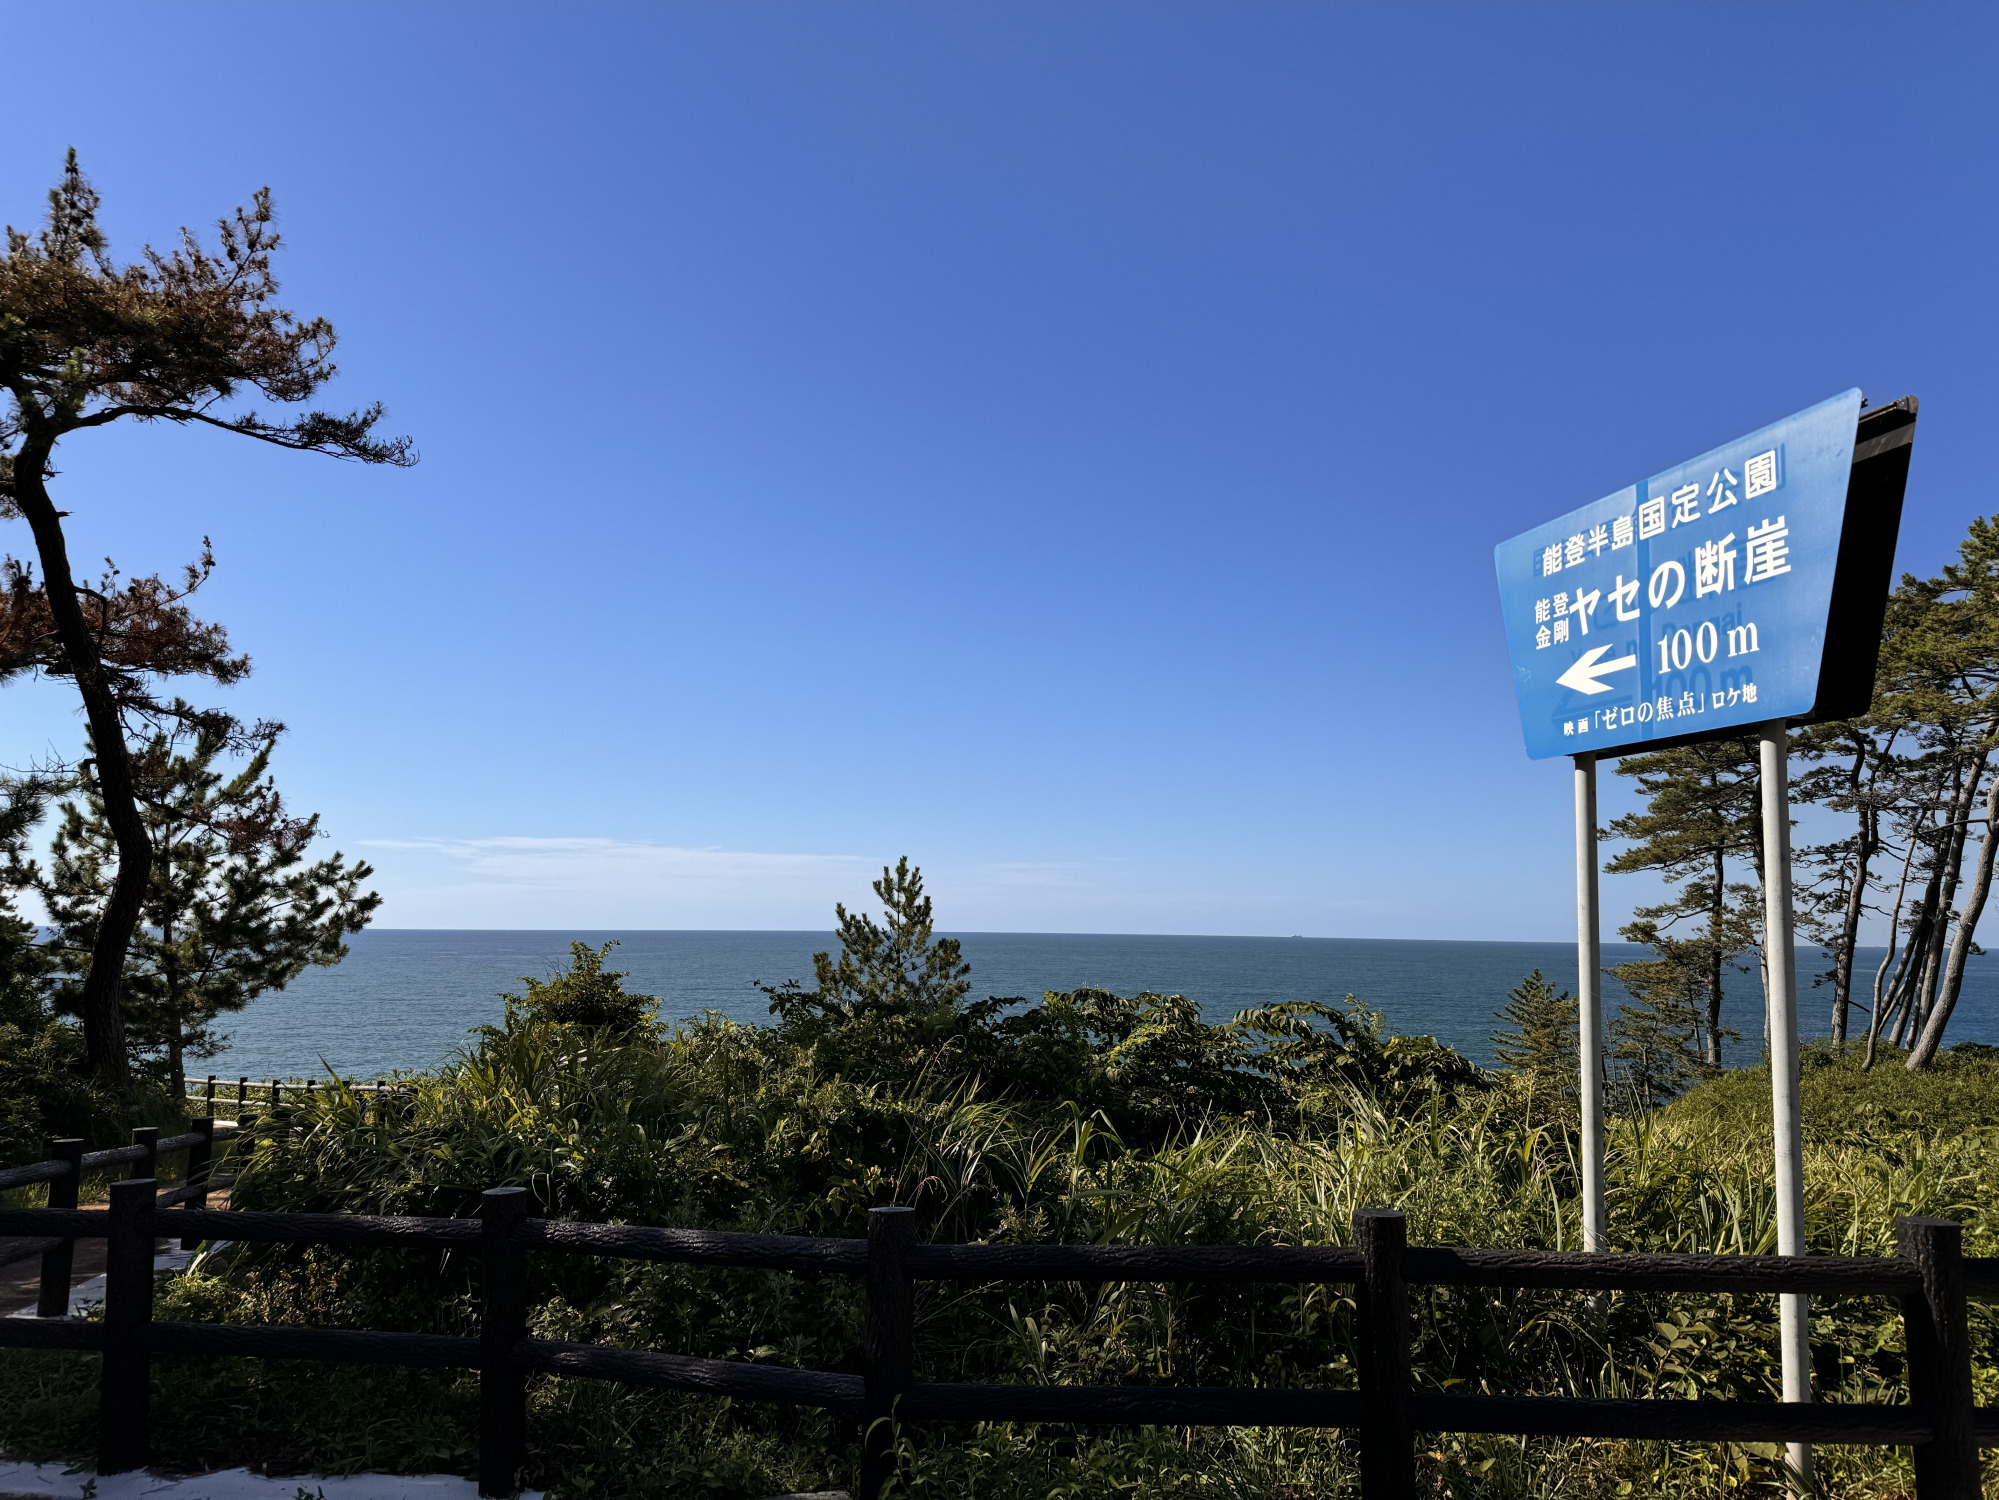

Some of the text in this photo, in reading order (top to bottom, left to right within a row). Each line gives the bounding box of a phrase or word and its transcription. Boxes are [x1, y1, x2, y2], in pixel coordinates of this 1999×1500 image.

[1542, 449, 1777, 577] 能登半島国定公園
[1569, 516, 1791, 636] ヤセの断崖
[1535, 592, 1569, 624] 能登
[1535, 620, 1569, 651] 金剛
[1656, 622, 1718, 674] 100
[1728, 622, 1760, 657] m
